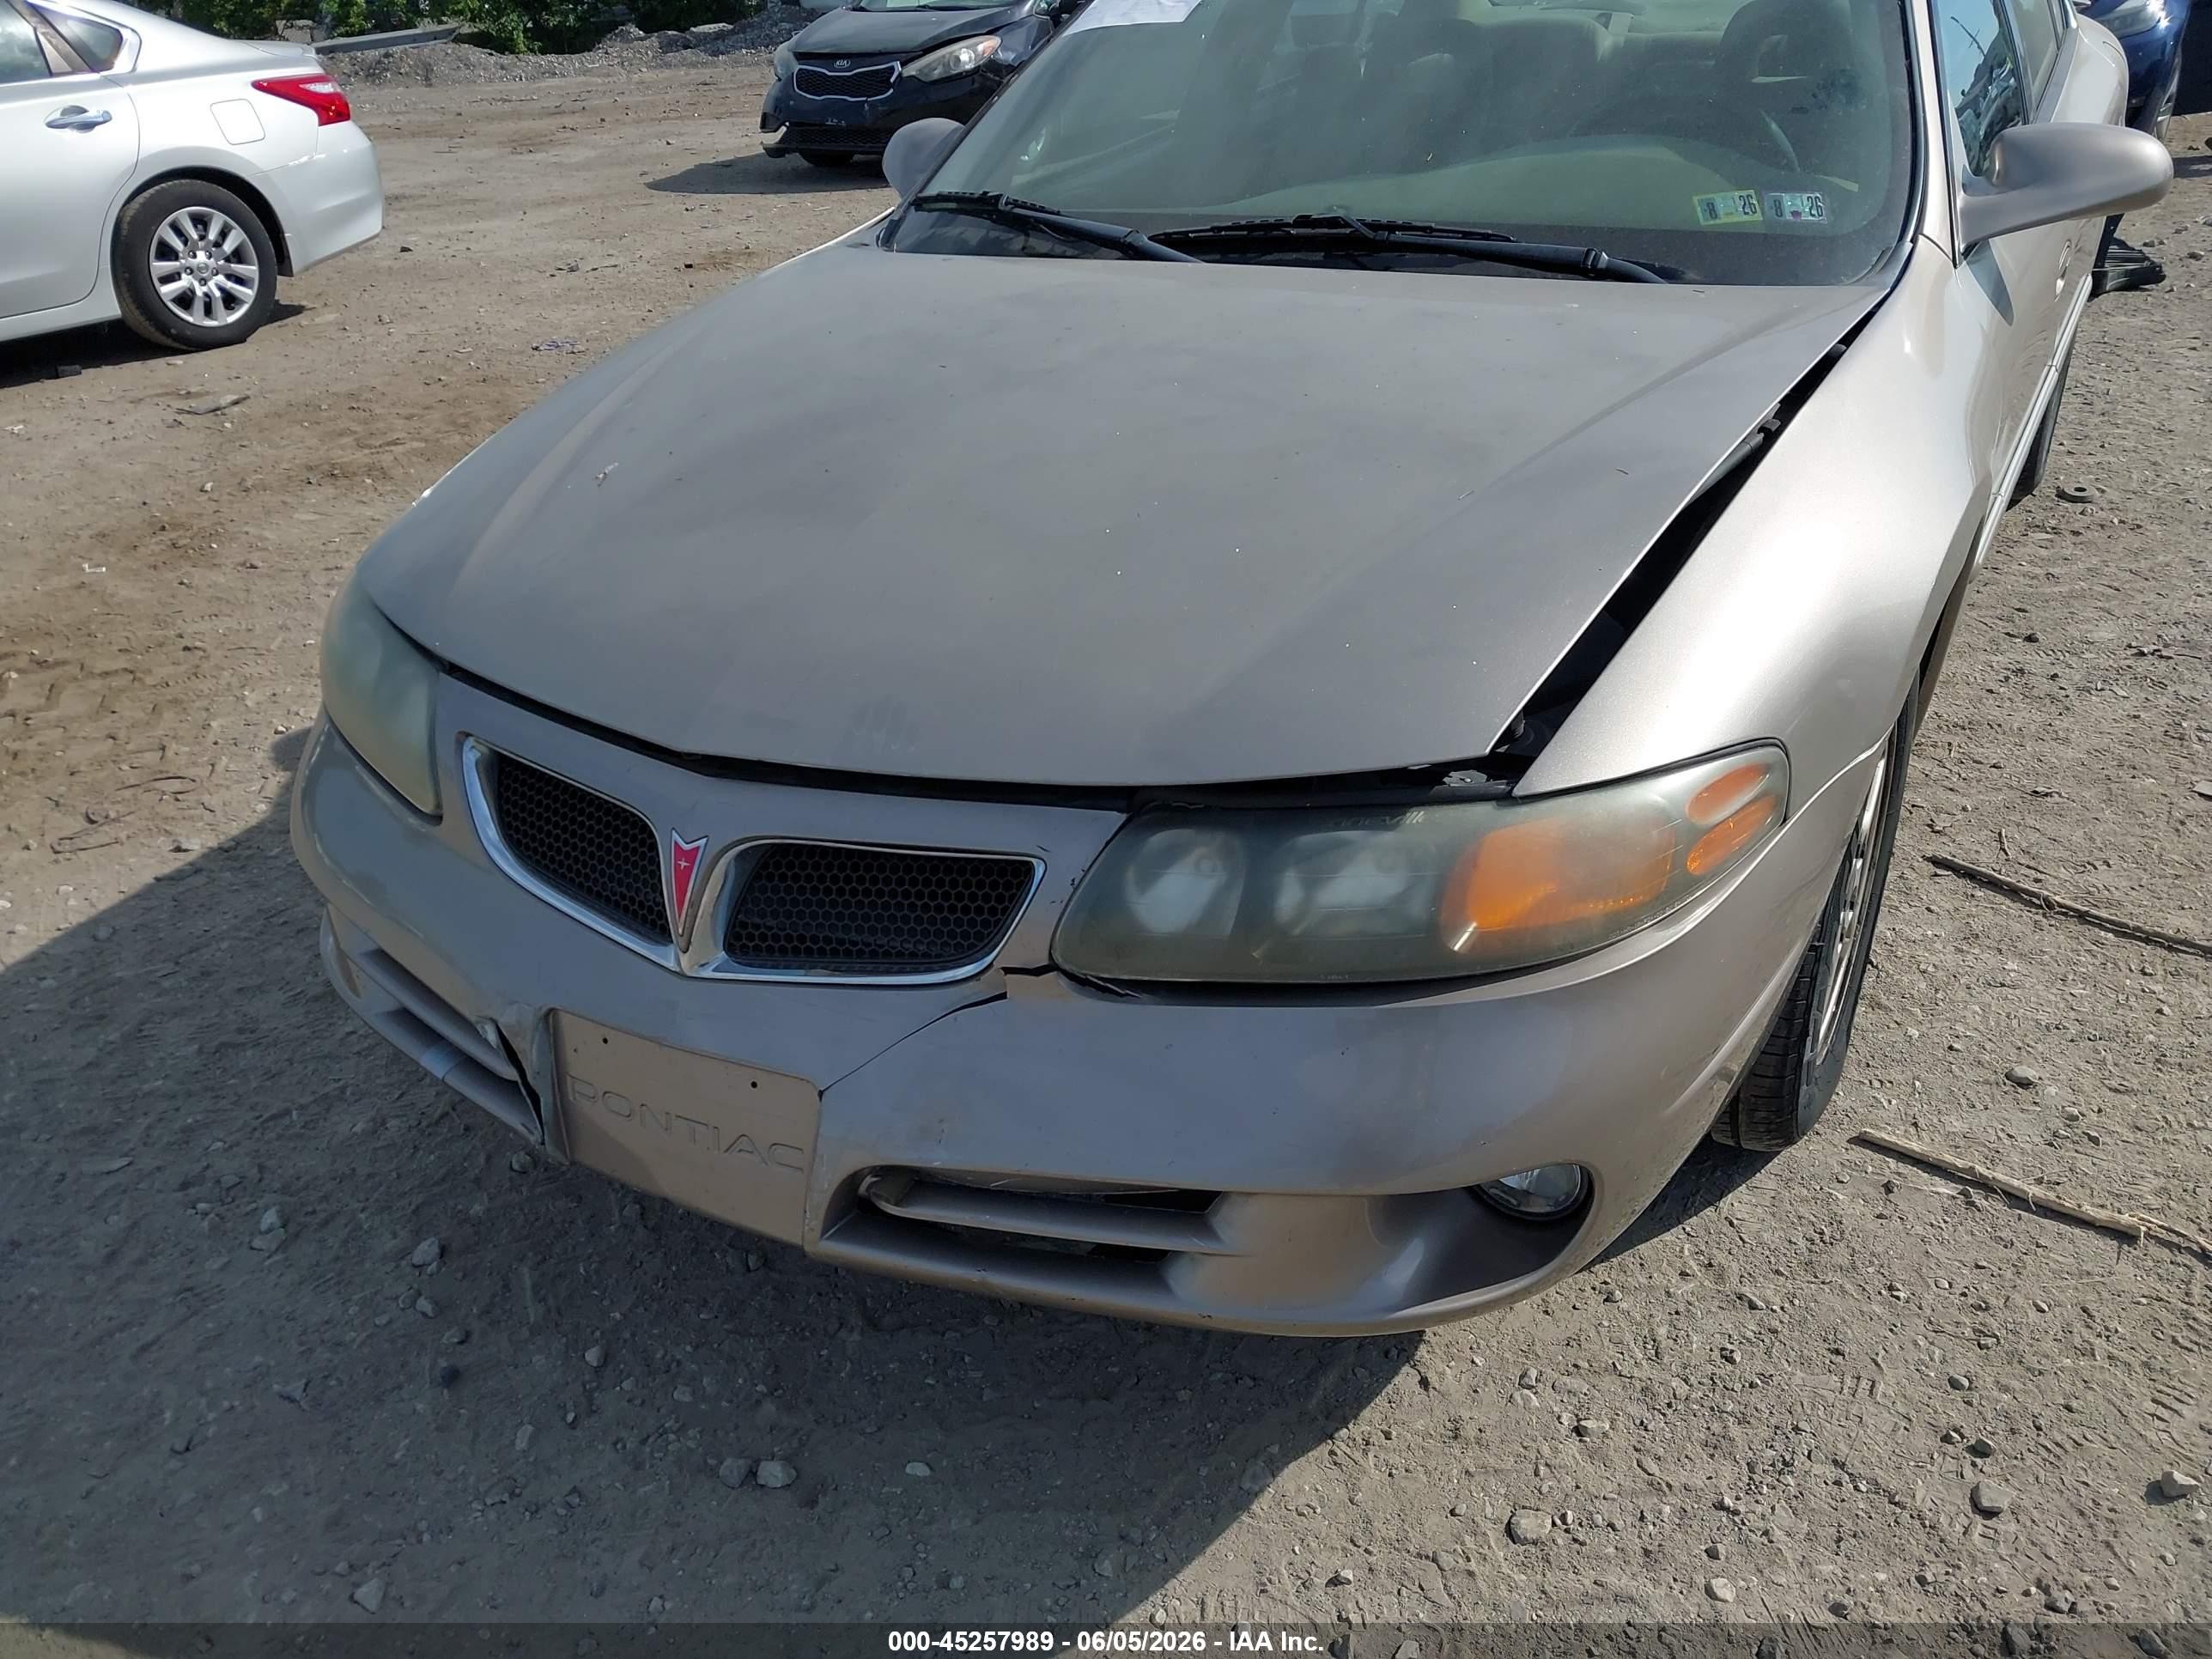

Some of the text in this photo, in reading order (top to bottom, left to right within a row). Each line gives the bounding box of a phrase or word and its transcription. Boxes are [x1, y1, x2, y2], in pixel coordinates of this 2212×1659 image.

[1705, 194, 1757, 220] 8 26
[1773, 196, 1824, 218] 8 26
[567, 1073, 805, 1175] PONTIAC
